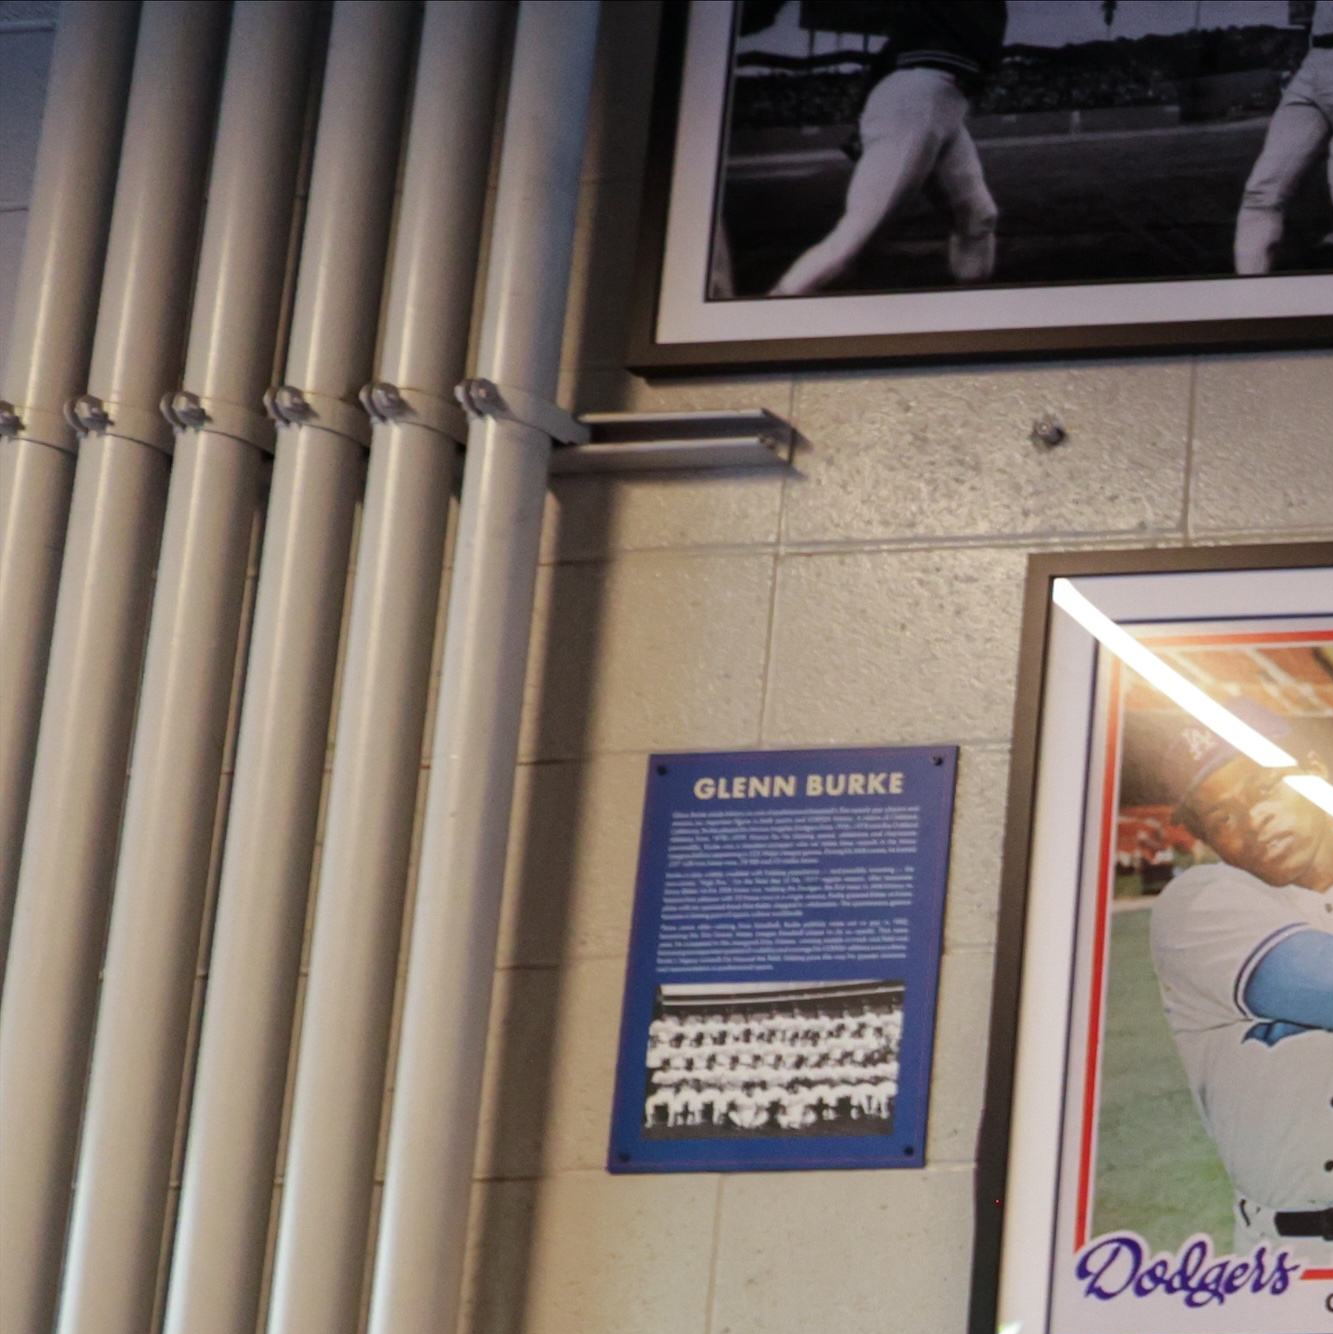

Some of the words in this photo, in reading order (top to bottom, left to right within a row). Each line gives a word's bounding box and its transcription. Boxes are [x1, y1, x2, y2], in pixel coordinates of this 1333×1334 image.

[694, 775, 771, 800] GLENN
[806, 772, 904, 798] BURKE
[1076, 1237, 1299, 1308] Dodgers
